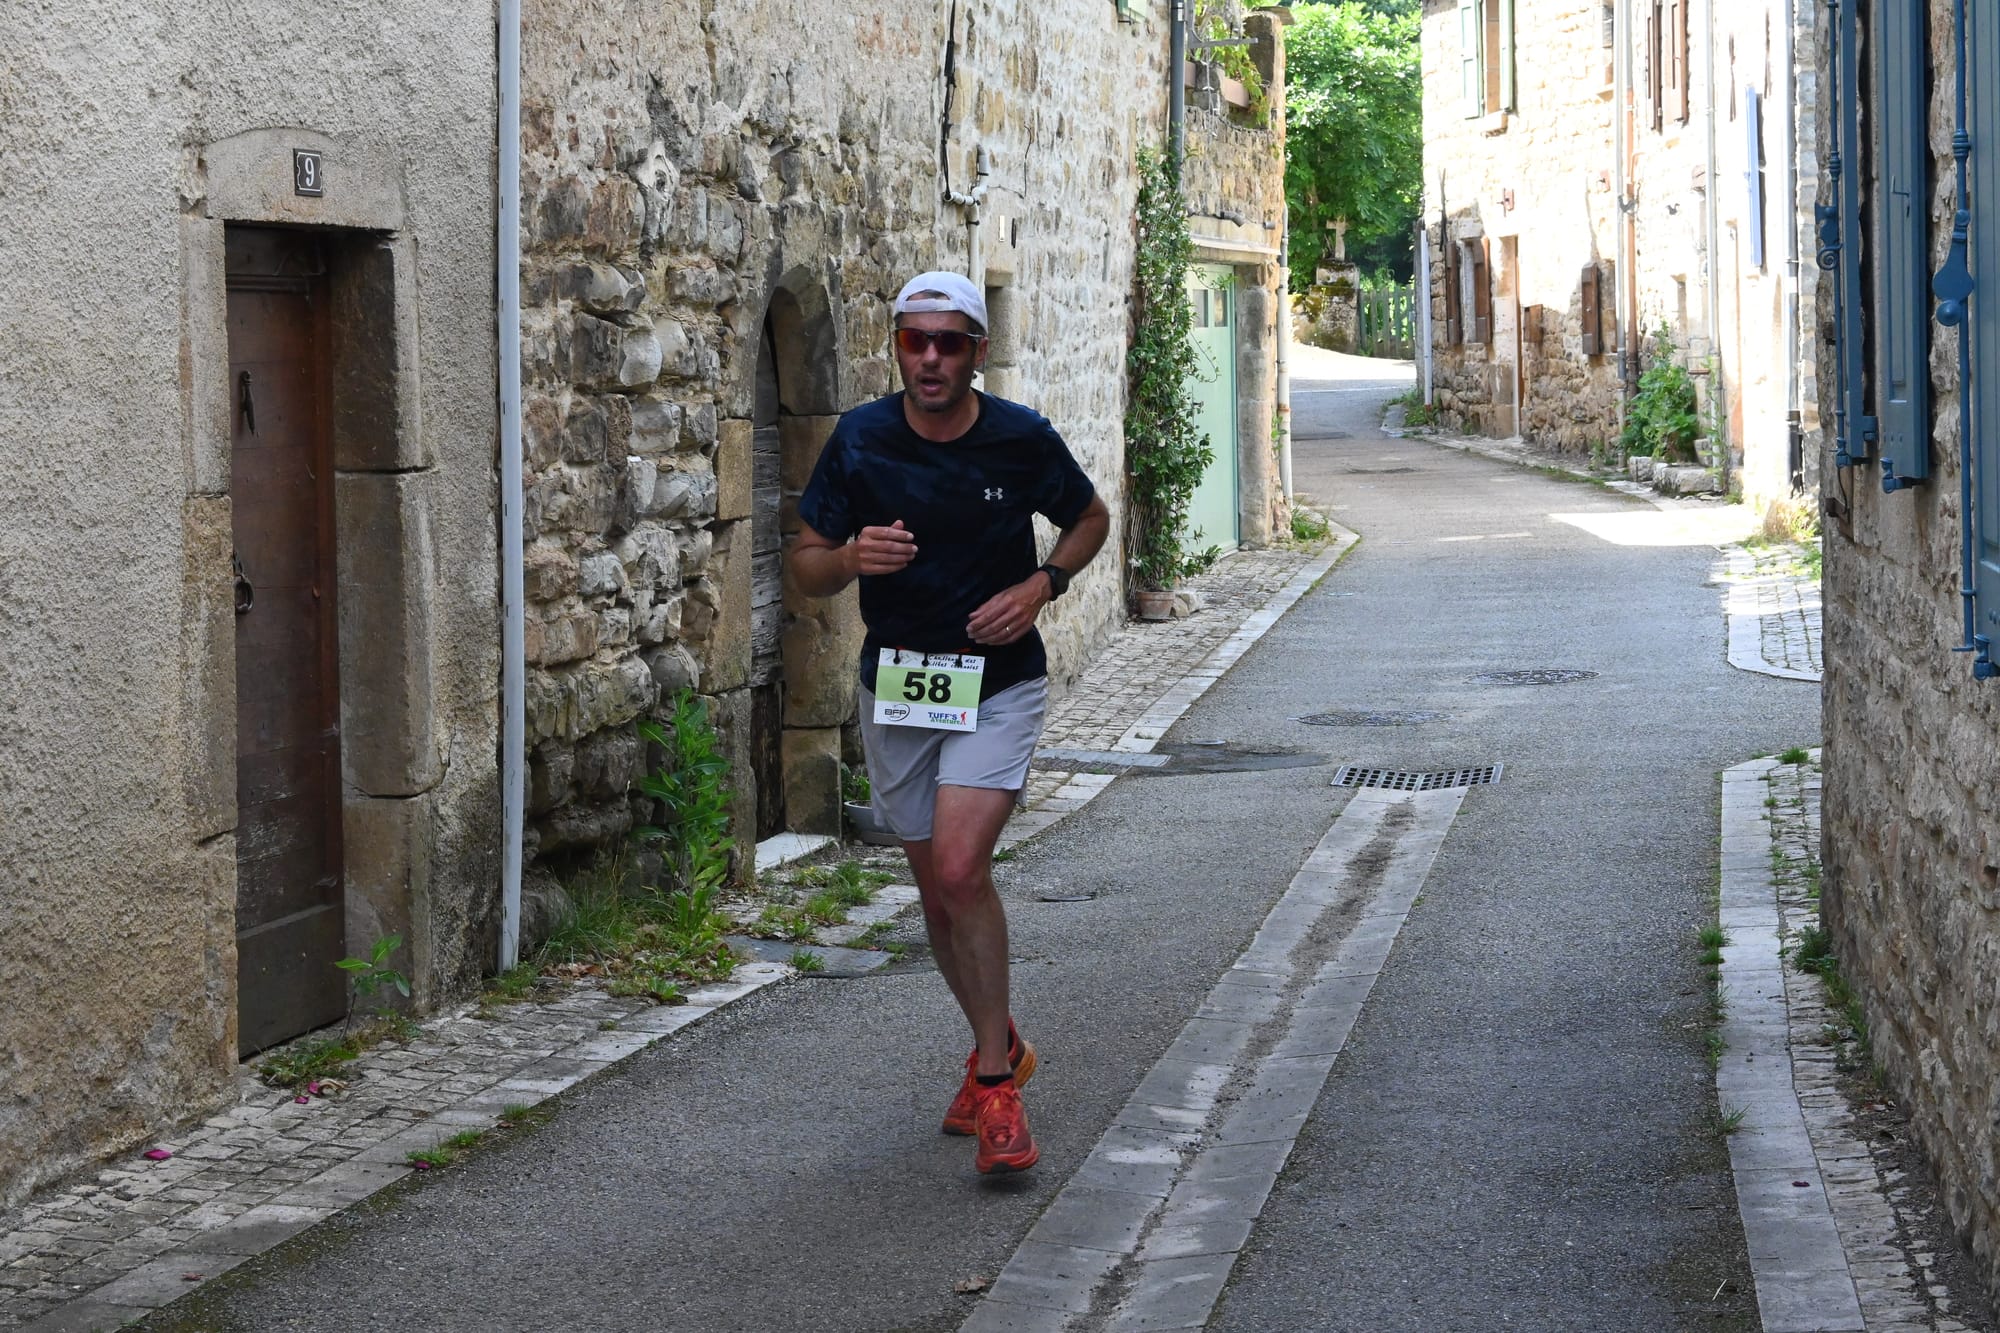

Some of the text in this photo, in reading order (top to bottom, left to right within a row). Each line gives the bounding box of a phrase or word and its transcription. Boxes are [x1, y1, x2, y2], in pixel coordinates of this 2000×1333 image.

[305, 157, 314, 187] 9
[902, 671, 952, 704] 58
[928, 711, 958, 721] TUFF'S
